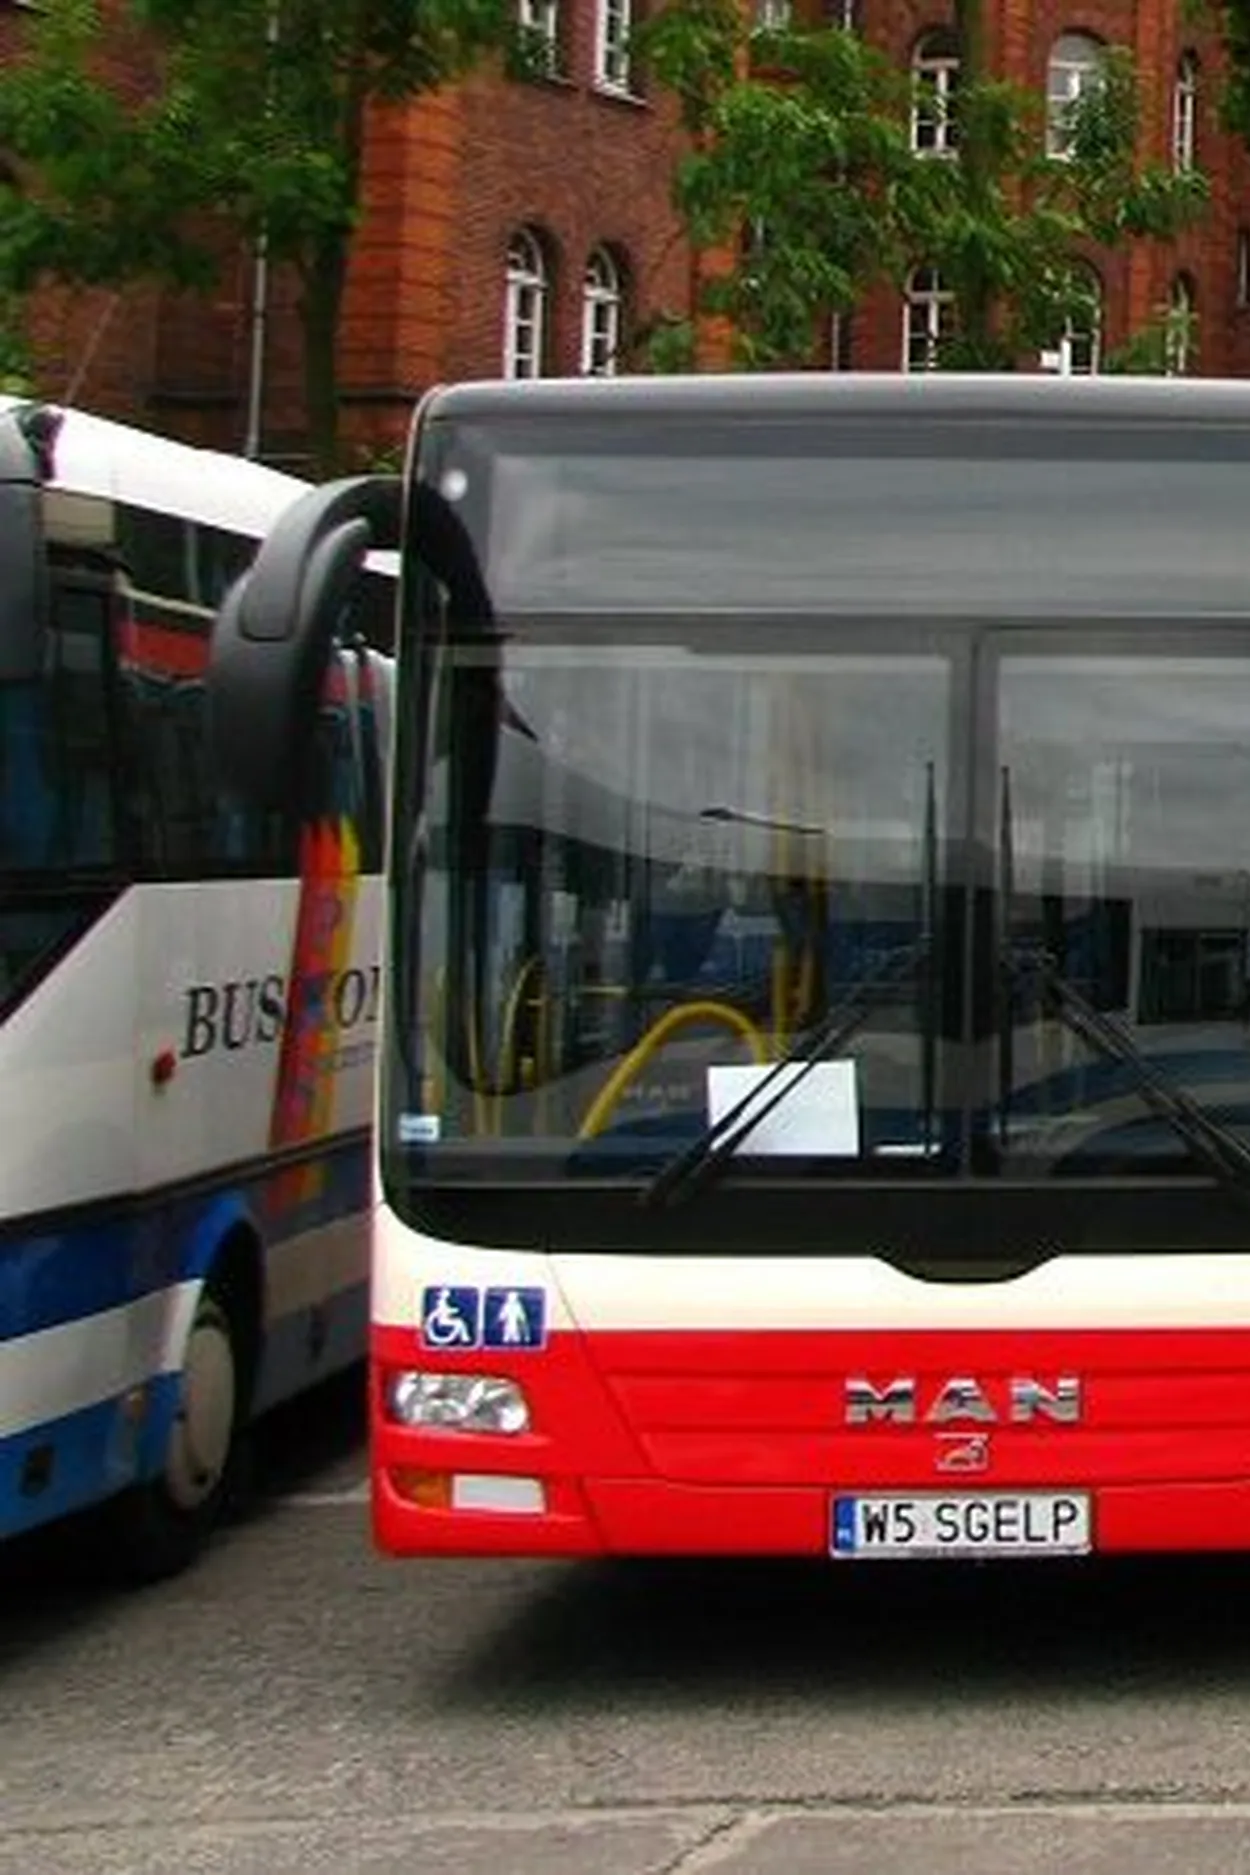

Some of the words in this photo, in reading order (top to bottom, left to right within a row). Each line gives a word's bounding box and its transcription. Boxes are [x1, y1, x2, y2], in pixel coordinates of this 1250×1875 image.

[844, 1377, 1080, 1424] MAN
[862, 1502, 915, 1544] W5
[934, 1499, 1078, 1543] SGELP
